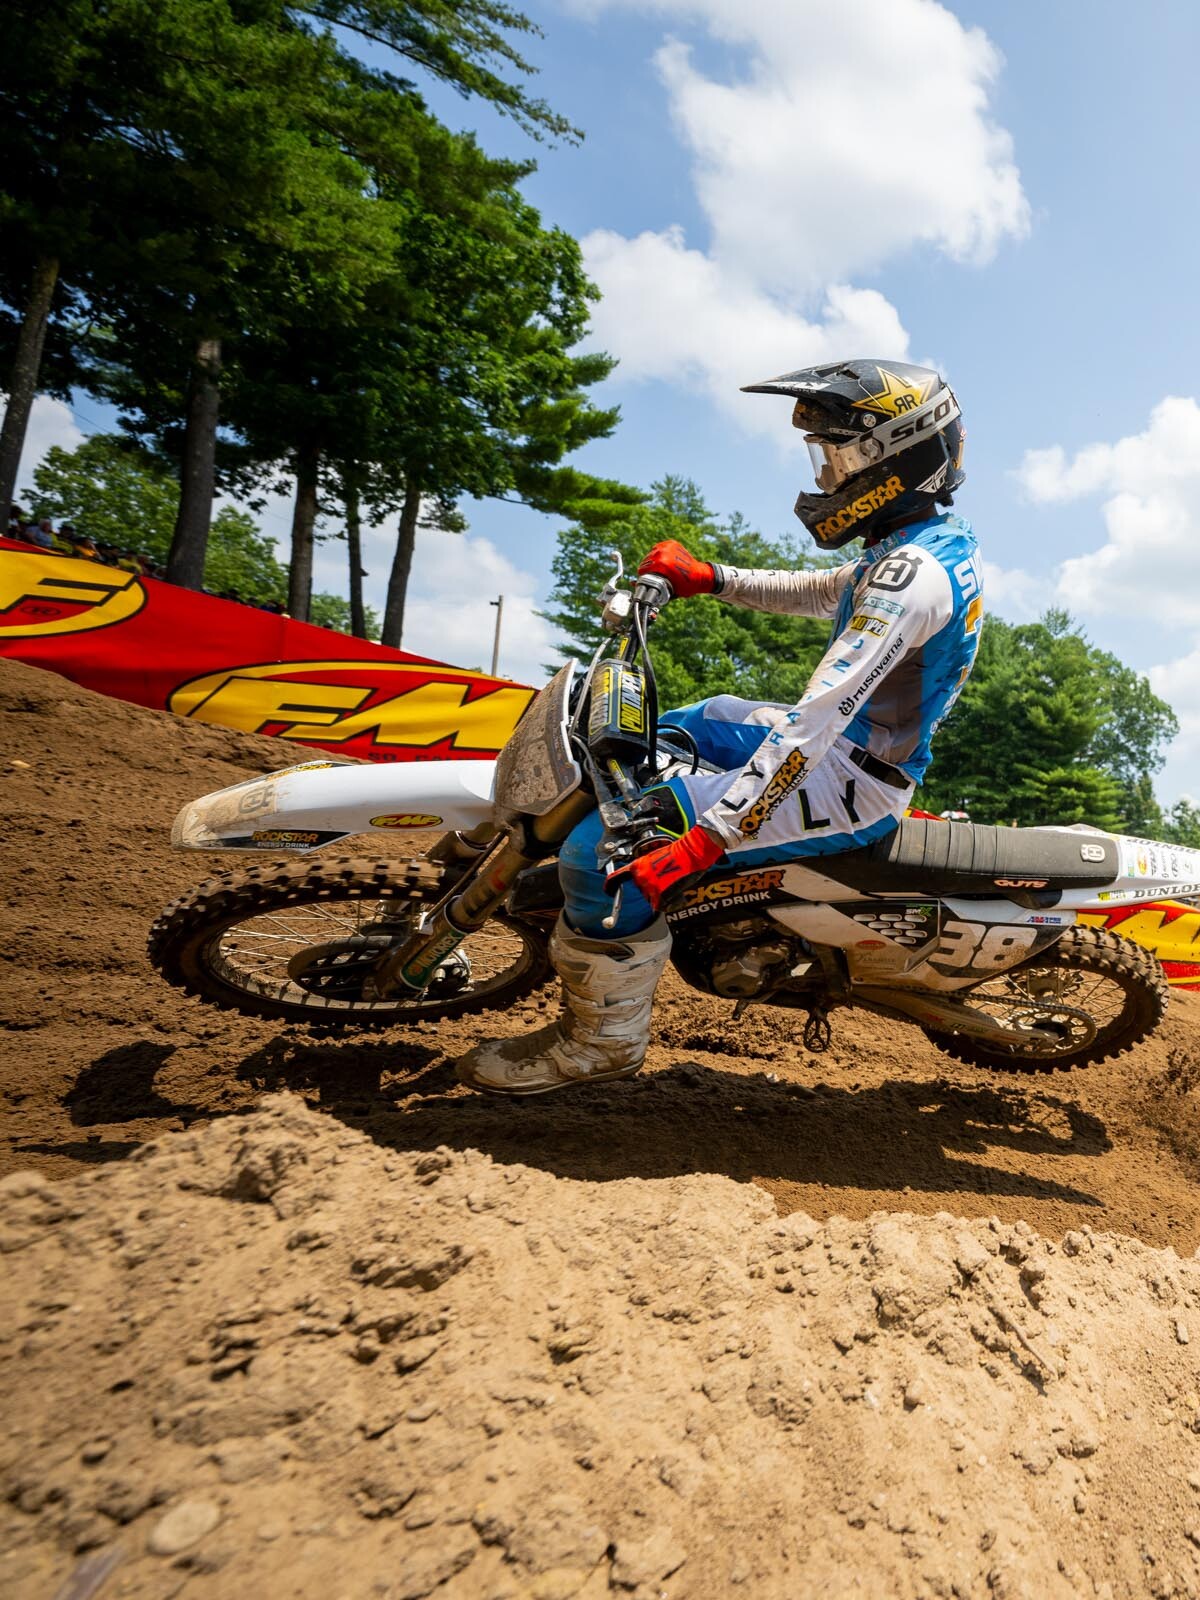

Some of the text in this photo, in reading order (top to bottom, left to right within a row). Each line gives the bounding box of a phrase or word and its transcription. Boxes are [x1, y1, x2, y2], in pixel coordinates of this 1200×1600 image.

[815, 475, 906, 541] ROCKSTAR
[190, 676, 540, 750] FM
[737, 747, 810, 837] OCKSTAR
[798, 779, 861, 831] LY
[253, 831, 319, 842] ROCKSTAR
[371, 815, 442, 827] FMF
[666, 891, 771, 924] NERGY DRINK
[682, 869, 785, 906] CKSTAR
[926, 920, 1038, 969] 38
